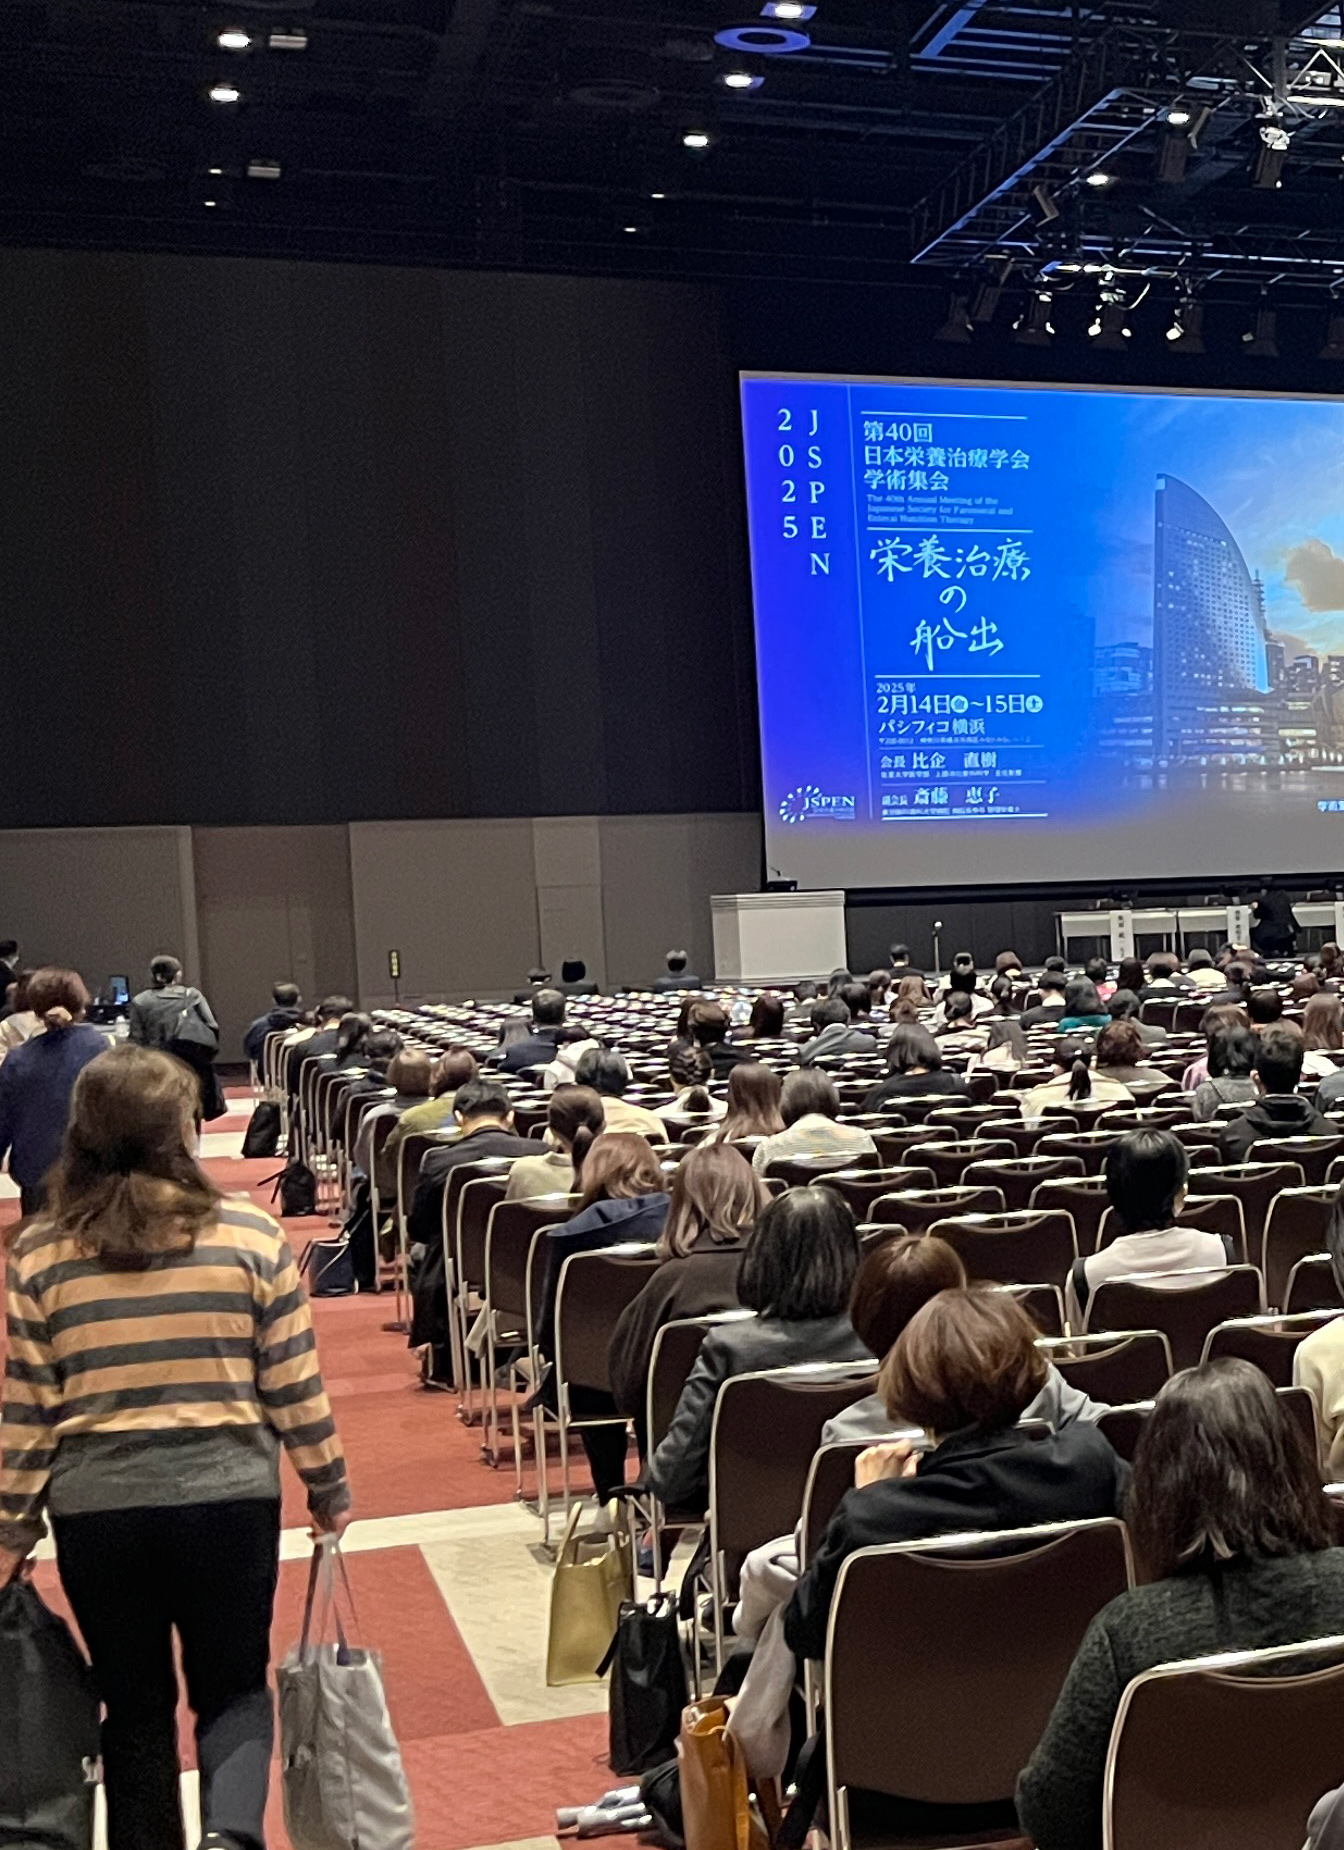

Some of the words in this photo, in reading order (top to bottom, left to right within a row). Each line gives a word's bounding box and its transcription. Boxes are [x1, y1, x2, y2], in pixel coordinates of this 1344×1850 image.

[863, 420, 933, 443] 第40回
[864, 444, 1030, 470] 日本栄養治療学会
[863, 468, 949, 491] 学術集会
[869, 534, 1031, 582] 栄養治療
[939, 585, 967, 613] の
[909, 616, 1004, 671] 船出
[876, 682, 916, 693] 2025年
[878, 718, 986, 735] パシフィコ横浜
[912, 752, 946, 769] 比企
[802, 795, 855, 811] JSPEN
